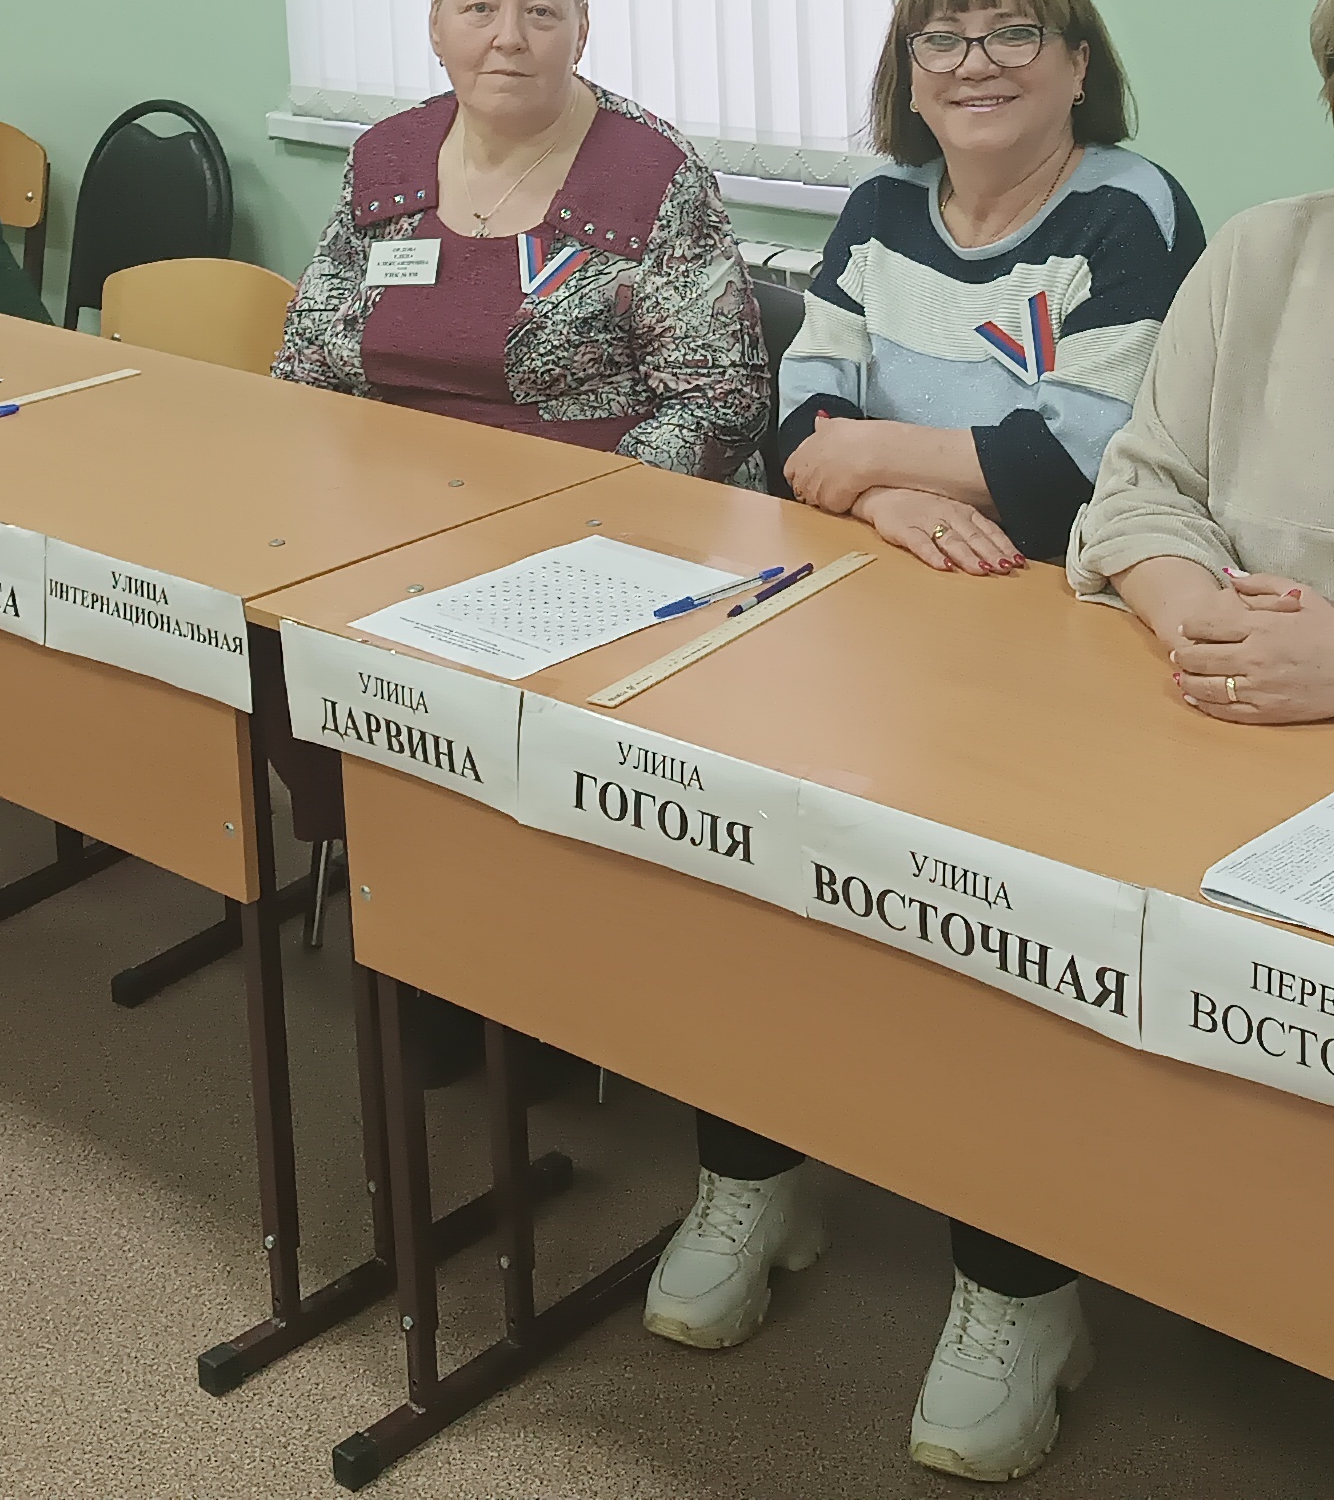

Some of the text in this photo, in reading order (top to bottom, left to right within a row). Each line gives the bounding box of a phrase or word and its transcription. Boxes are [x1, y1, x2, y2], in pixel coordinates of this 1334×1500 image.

[48, 578, 244, 656] ИНТЕРНАЦИОНАЛЬНАЯ
[110, 570, 169, 606] УЛИЦА
[357, 671, 430, 715] УЛИЦА
[320, 696, 485, 784] ДАРВИНА
[617, 741, 706, 792] УЛИЦА
[573, 770, 755, 865] ГОГОЛЯ
[908, 850, 1014, 911] УЛИЦА
[810, 860, 1130, 1018] ВОСТОЧНАЯ
